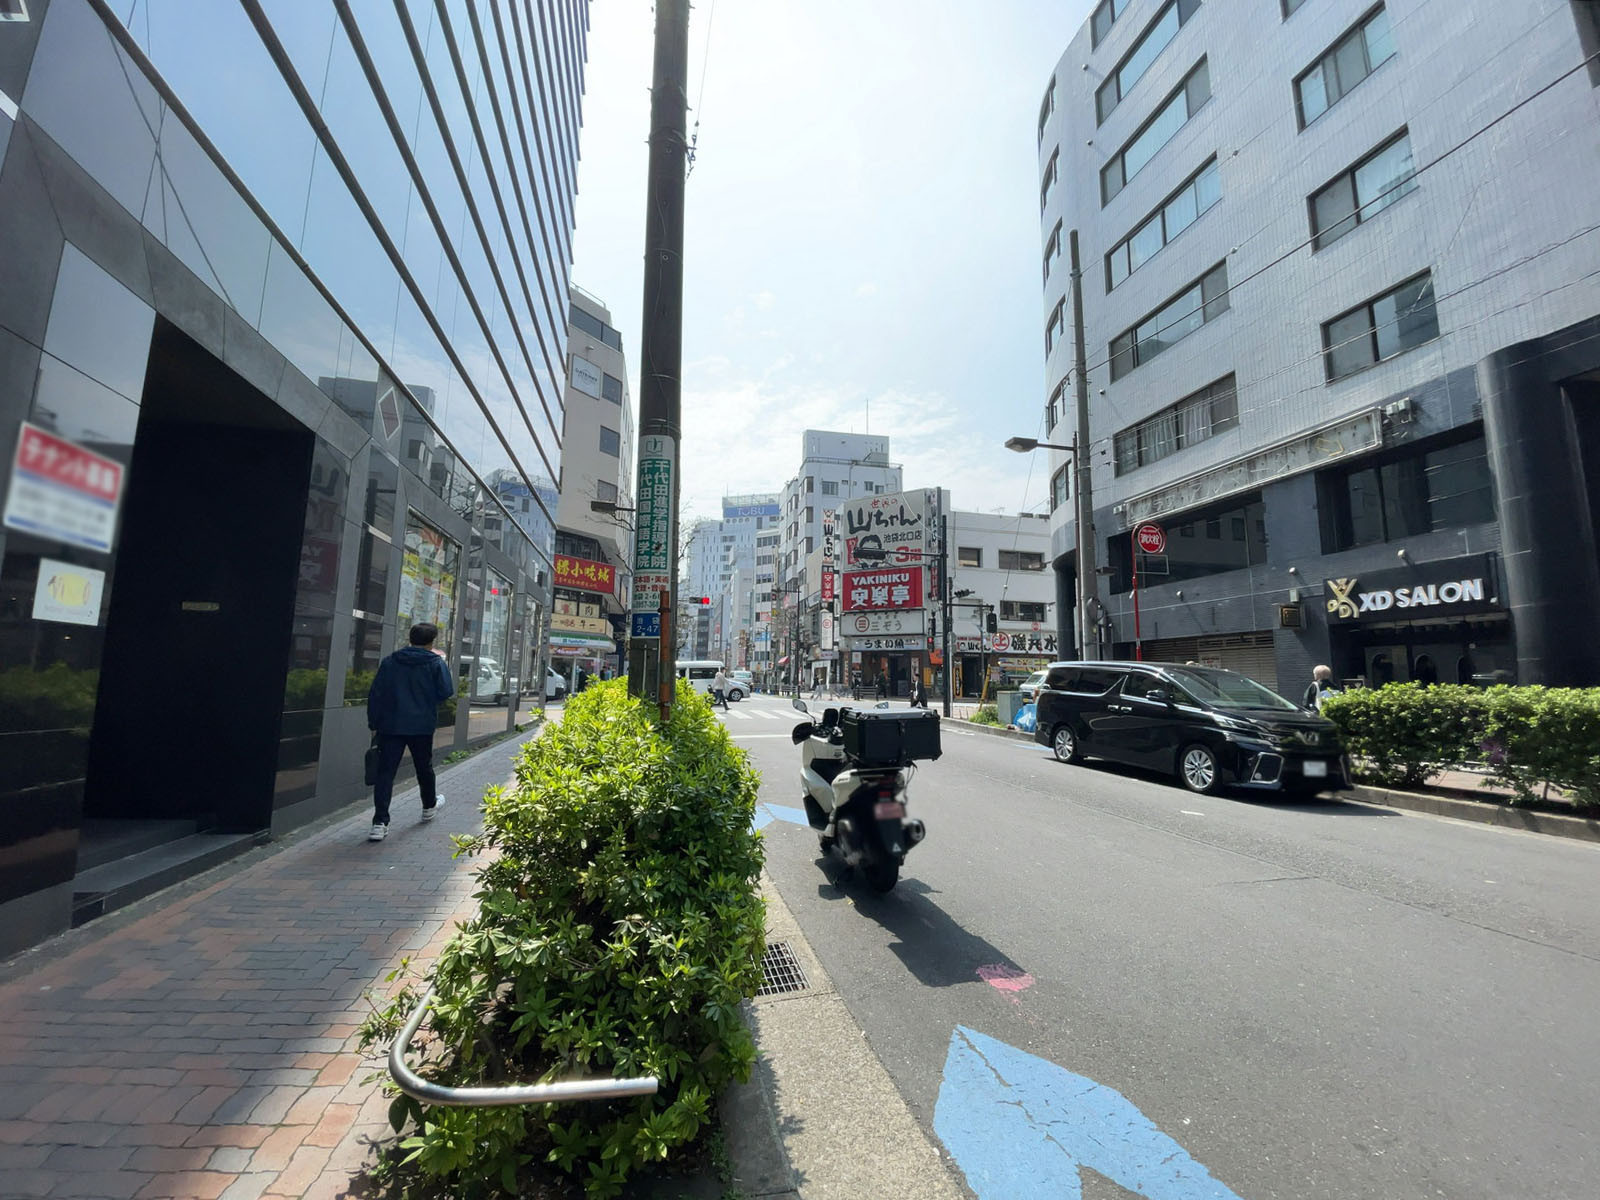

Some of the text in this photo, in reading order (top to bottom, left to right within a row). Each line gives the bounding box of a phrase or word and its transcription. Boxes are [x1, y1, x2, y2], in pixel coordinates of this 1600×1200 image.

[637, 461, 653, 569] 千代田国際語学院
[737, 506, 765, 516] TOBU
[847, 505, 922, 535] 山ちゃん
[883, 529, 922, 544] 池袋北口店
[851, 573, 910, 586] YAKINIKU
[1358, 578, 1484, 613] XD SALON
[864, 638, 905, 649] うまい魚
